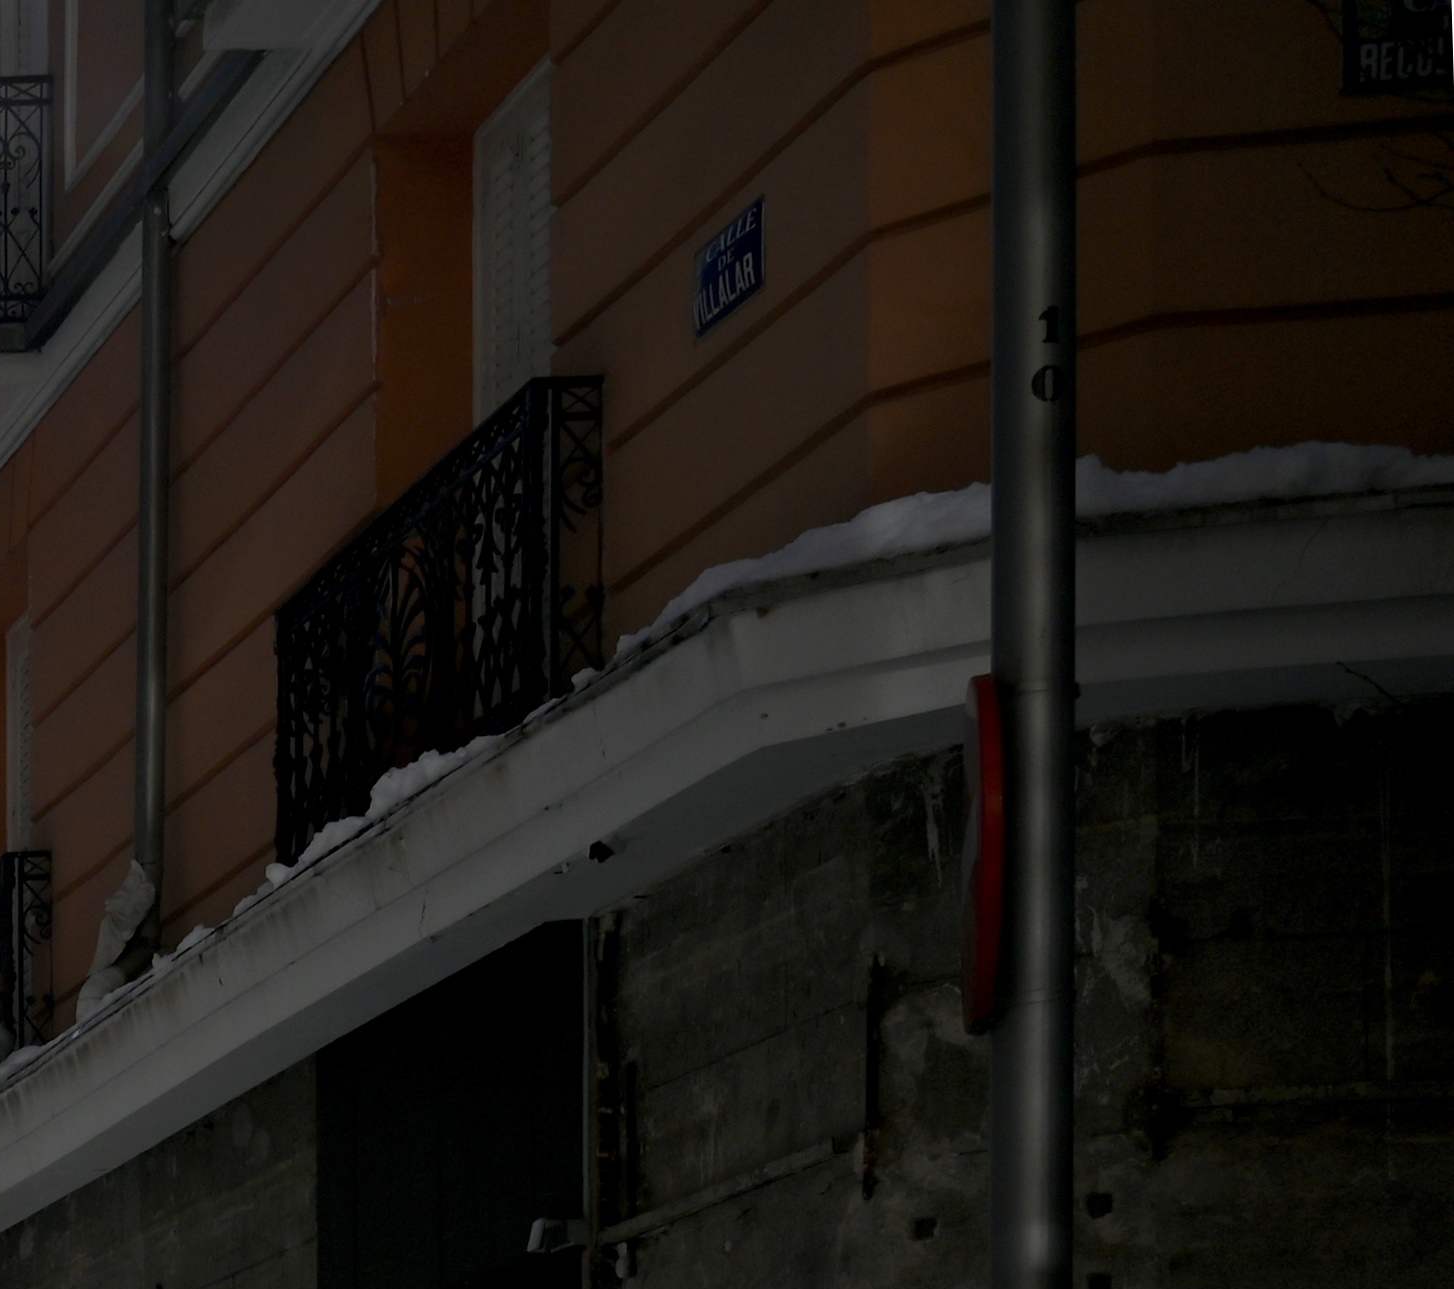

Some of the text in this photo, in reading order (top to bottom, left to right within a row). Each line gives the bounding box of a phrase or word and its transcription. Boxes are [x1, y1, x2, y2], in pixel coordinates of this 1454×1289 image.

[704, 207, 758, 263] CALLE
[717, 244, 736, 272] DE
[692, 251, 756, 330] VILLALAR
